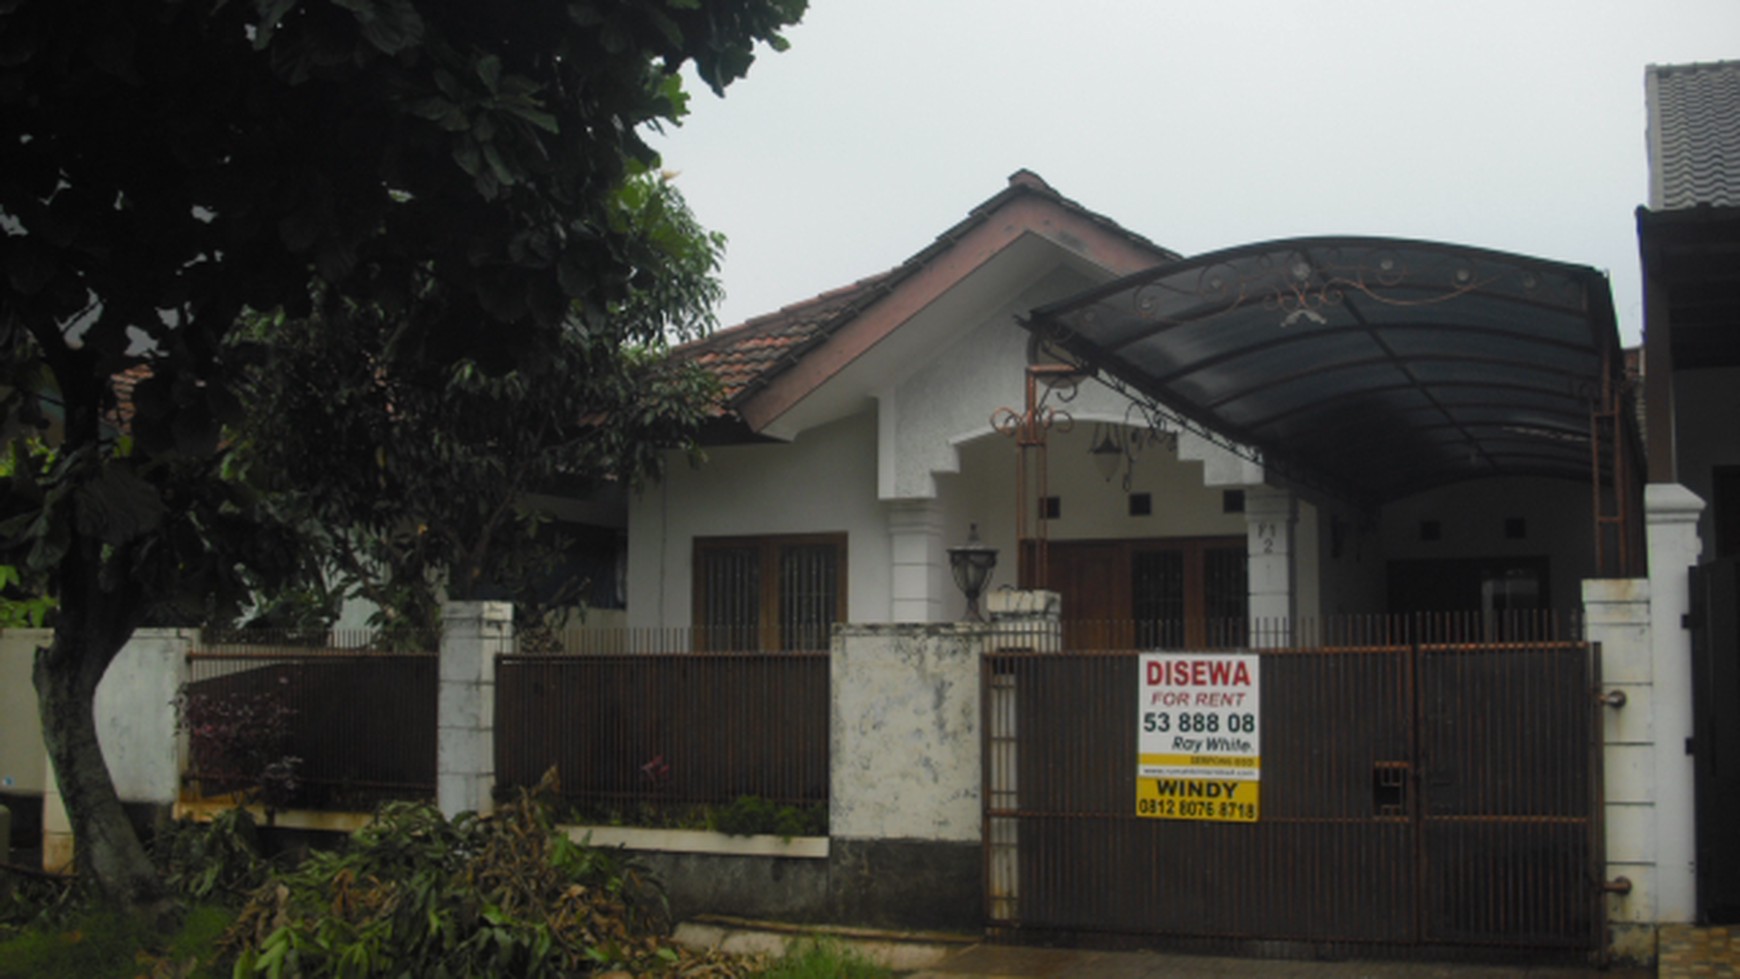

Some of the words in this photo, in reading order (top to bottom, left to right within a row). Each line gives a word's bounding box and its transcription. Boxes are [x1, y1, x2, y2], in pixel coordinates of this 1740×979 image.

[1146, 660, 1251, 686] DISEWA
[1151, 691, 1190, 707] FOR
[1195, 692, 1246, 708] RENT
[1143, 712, 1170, 733] 53
[1178, 712, 1219, 733] 888
[1227, 713, 1255, 733] 08
[1172, 736, 1203, 753] Ray
[1157, 779, 1238, 799] WINDY
[1139, 798, 1175, 815] 0812
[1179, 800, 1215, 817] 8076
